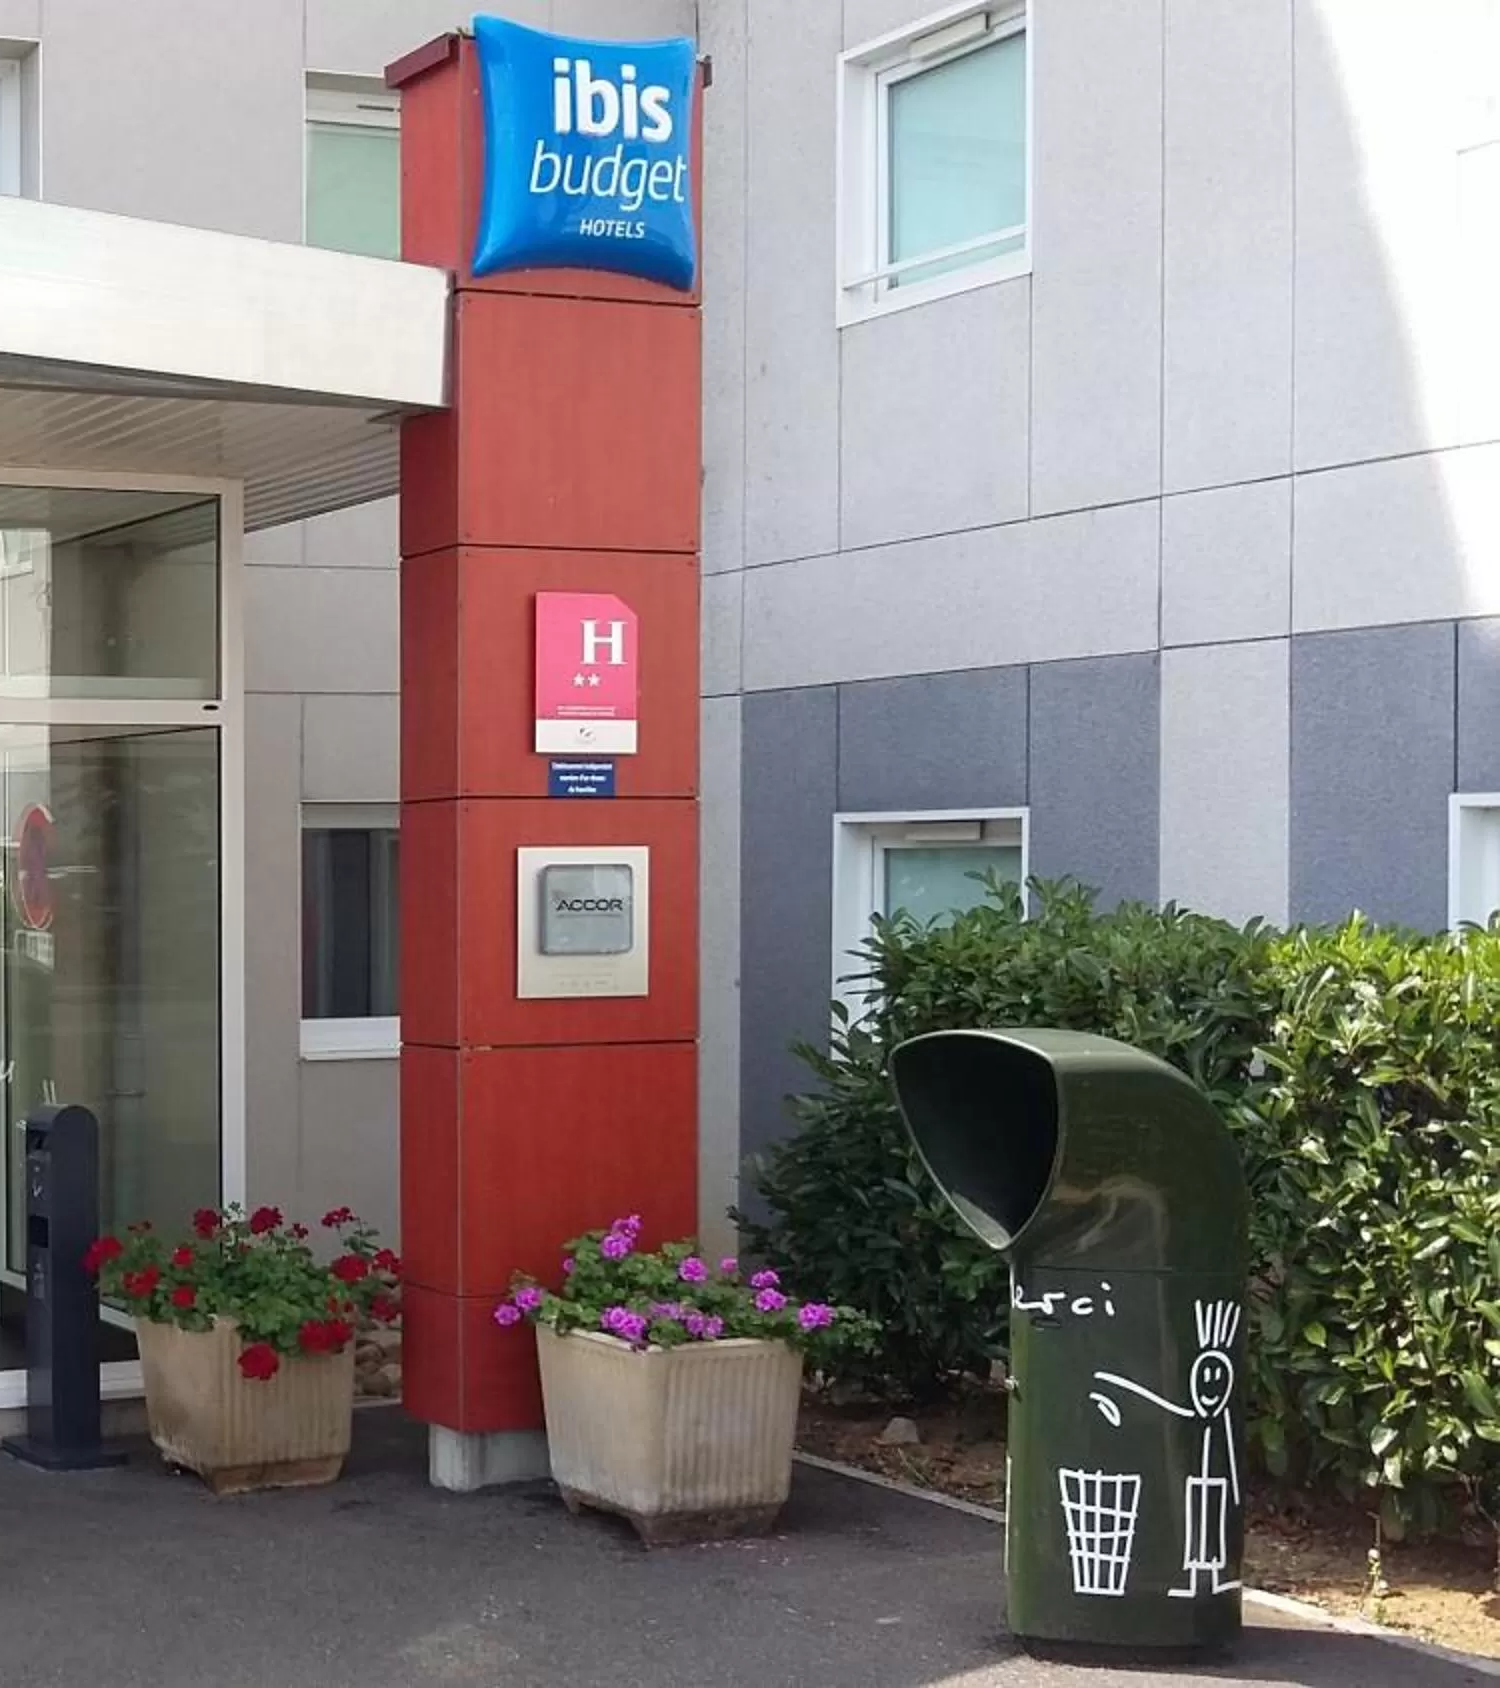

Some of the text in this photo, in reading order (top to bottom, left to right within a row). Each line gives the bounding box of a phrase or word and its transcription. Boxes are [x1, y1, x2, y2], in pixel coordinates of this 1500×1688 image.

[553, 57, 673, 142] ibis
[529, 139, 687, 212] budget
[579, 218, 646, 239] HOTELS
[579, 618, 628, 665] H
[556, 898, 624, 912] ACCOR
[1009, 1280, 1116, 1316] erci
